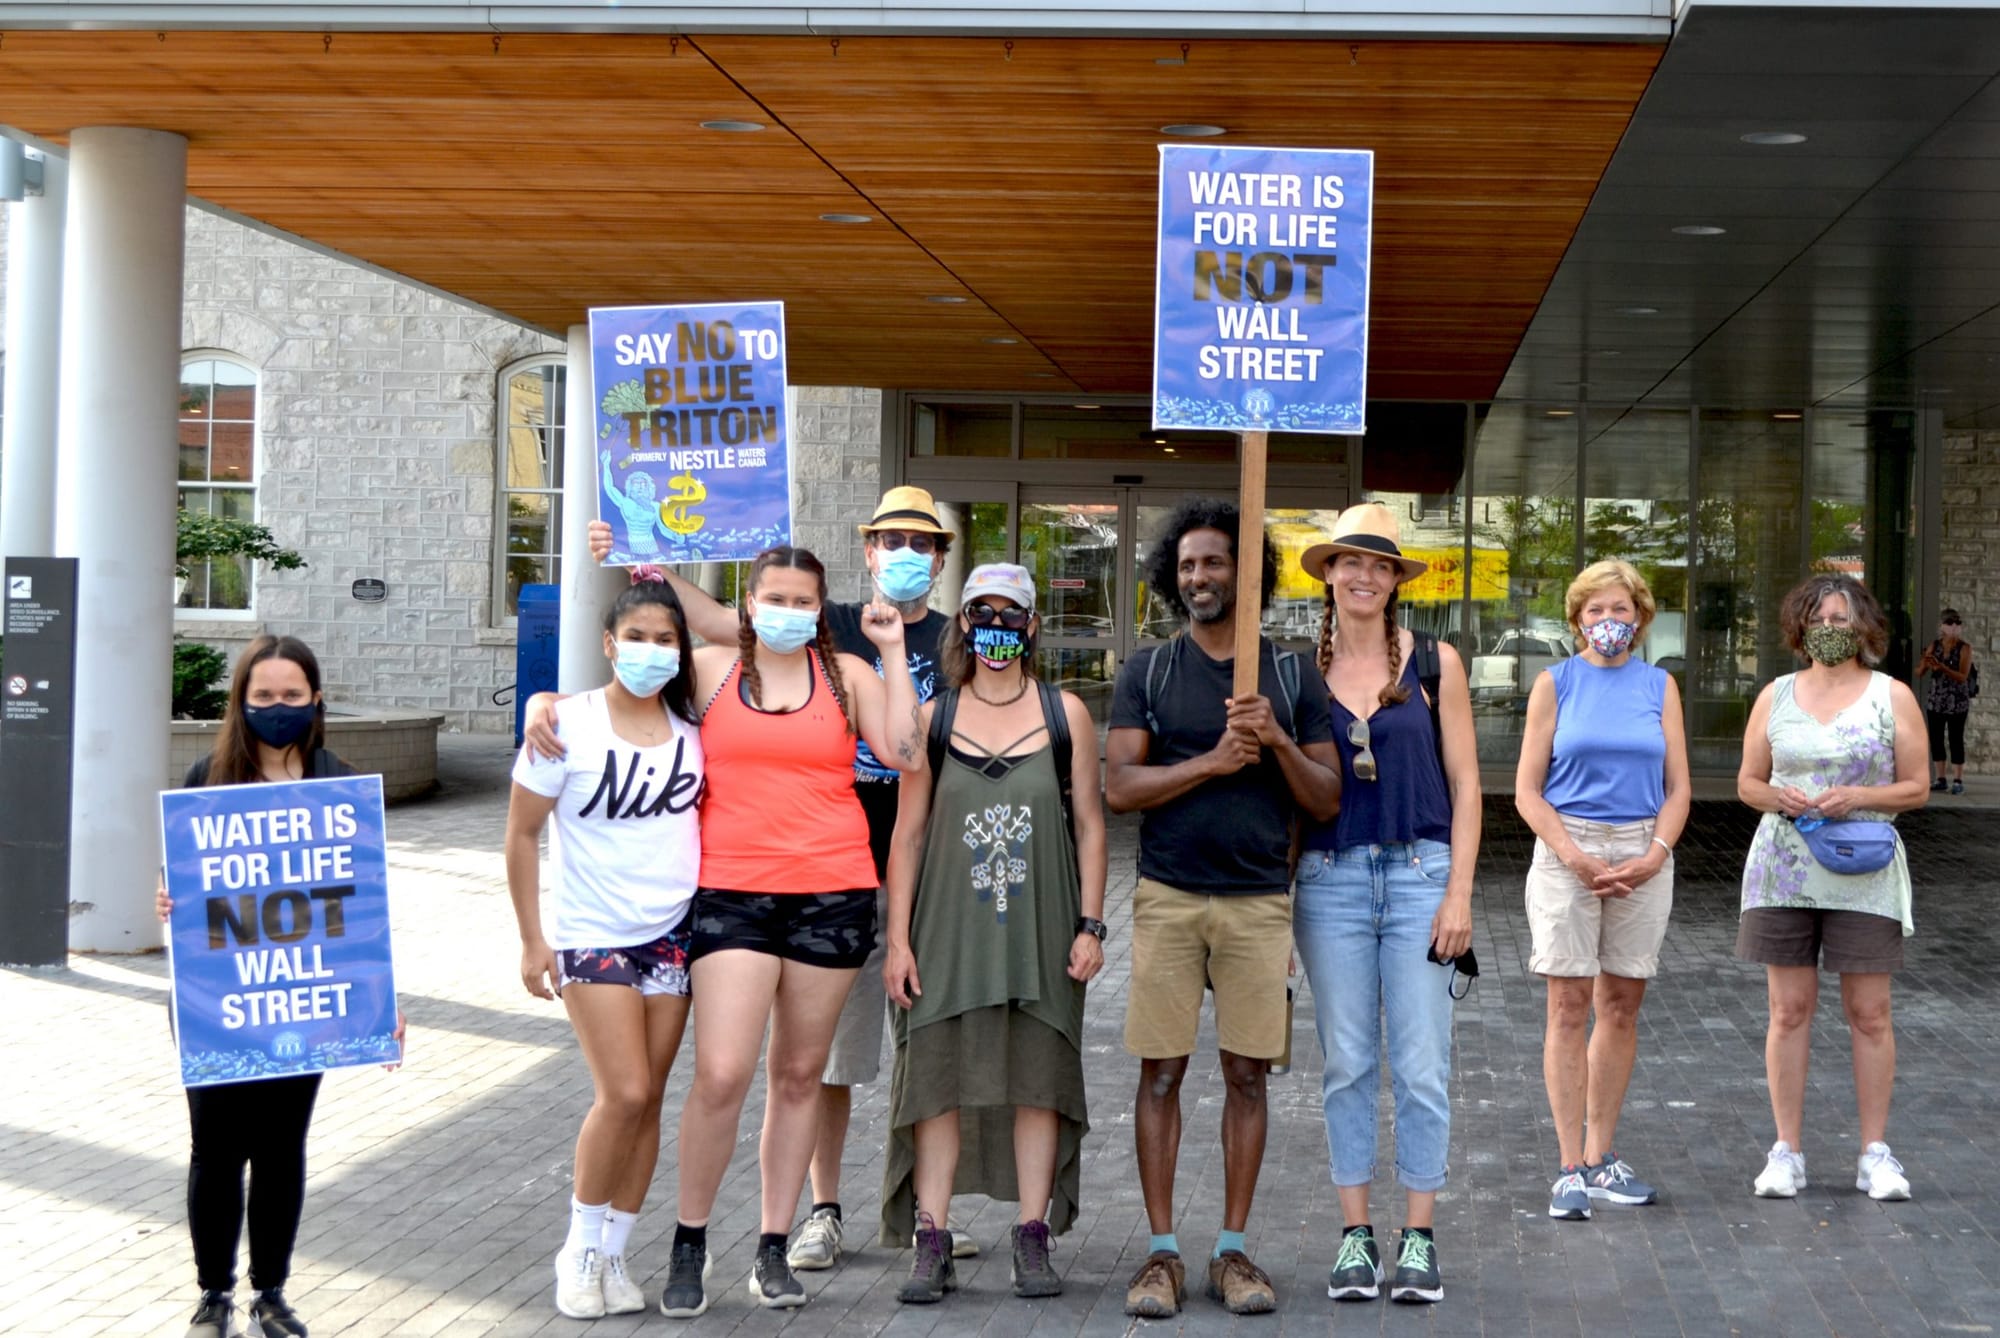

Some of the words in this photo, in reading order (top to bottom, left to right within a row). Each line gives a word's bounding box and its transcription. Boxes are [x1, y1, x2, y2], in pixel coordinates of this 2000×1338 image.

[1188, 171, 1302, 207] WATER
[1313, 175, 1344, 208] IS
[1193, 211, 1257, 246] FOR
[1269, 214, 1337, 248] LIFE
[1193, 251, 1337, 305] NOT
[615, 333, 672, 366] SAY
[676, 320, 736, 363] NO
[739, 329, 778, 361] TO
[1216, 306, 1308, 341] WALL
[1199, 346, 1324, 382] STREET
[643, 365, 753, 405] BLUE
[621, 406, 777, 449] TRITON
[631, 452, 667, 463] FORMERLY
[737, 448, 767, 458] WATERS
[738, 457, 767, 468] CANADA
[974, 627, 1019, 646] WATER
[986, 645, 1016, 661] LIFE
[191, 807, 313, 851] WATER
[323, 803, 357, 840] IS
[201, 853, 271, 892] FOR
[281, 845, 354, 885] LIFE
[205, 885, 356, 950] NOT
[235, 944, 334, 986] WALL
[221, 982, 352, 1030] STREET
